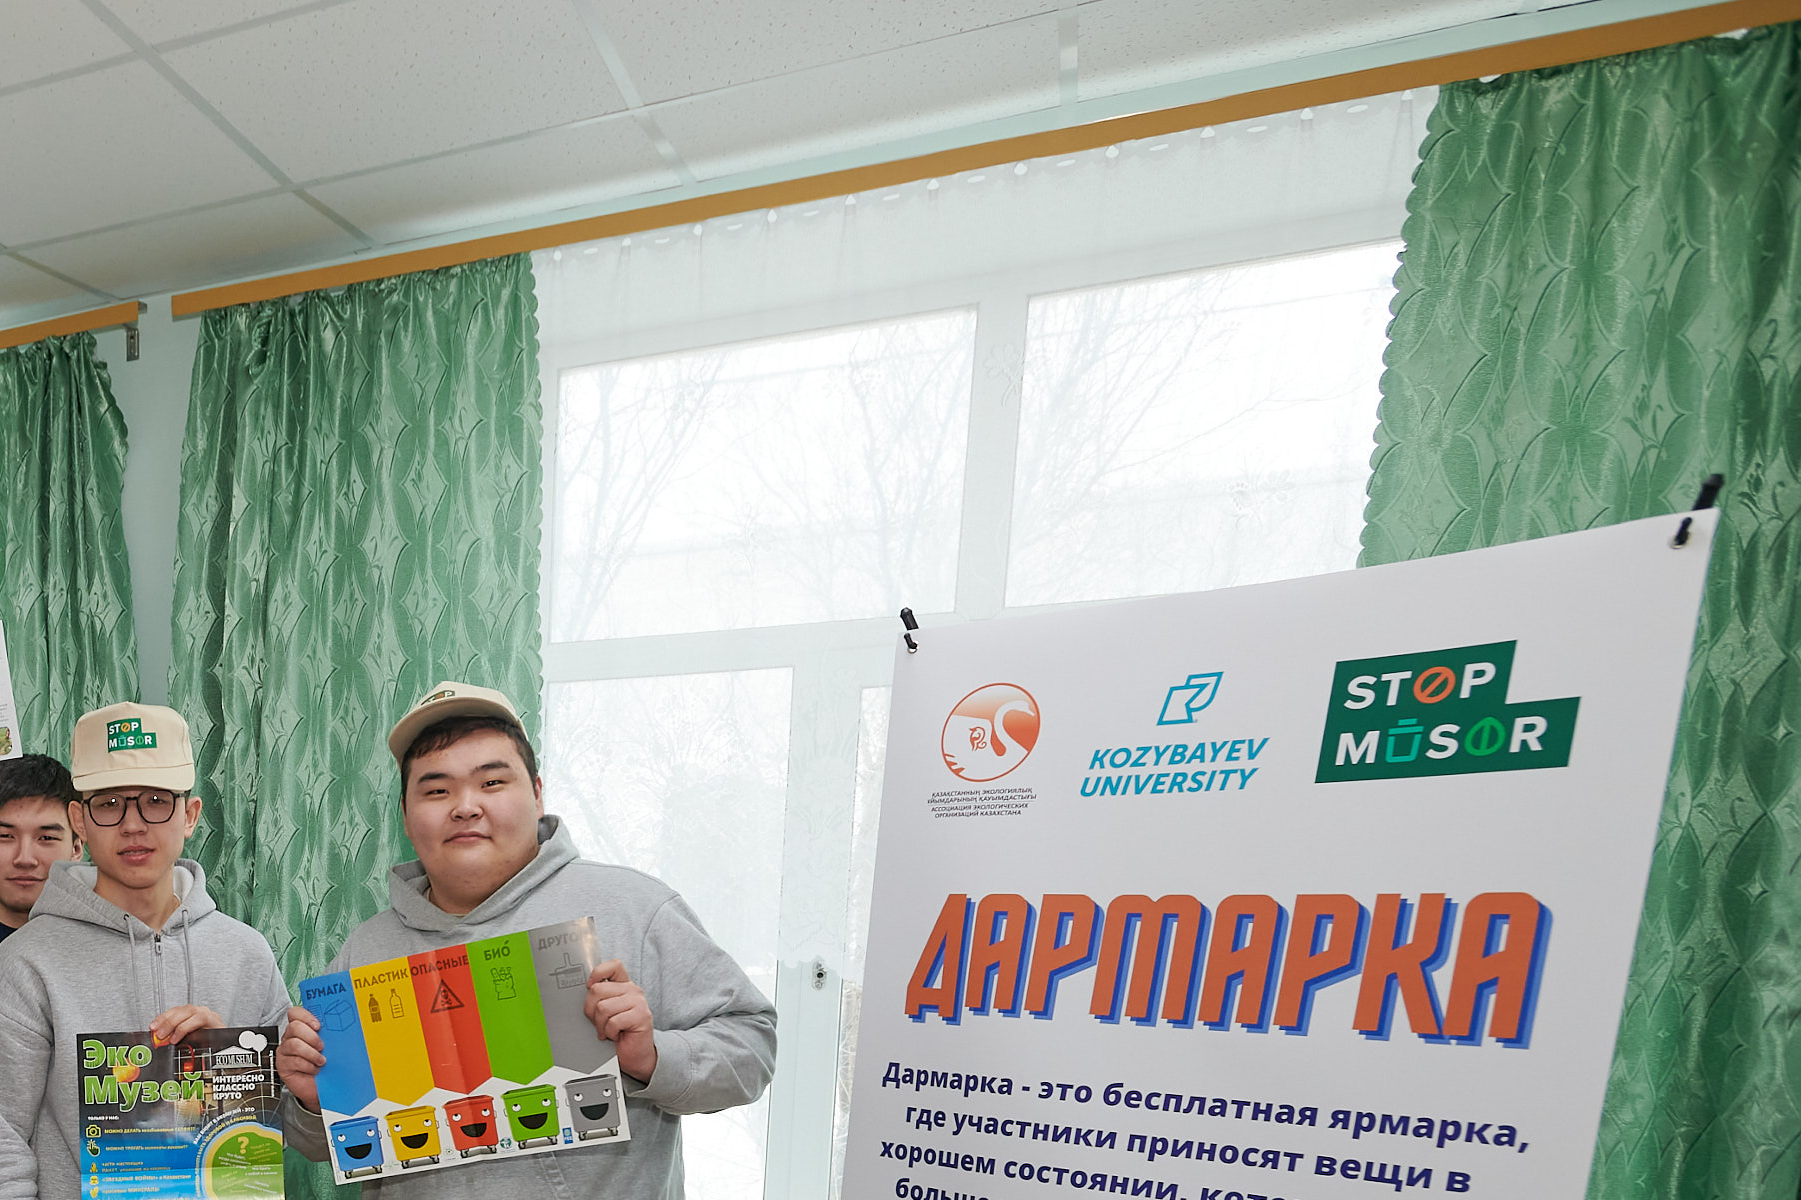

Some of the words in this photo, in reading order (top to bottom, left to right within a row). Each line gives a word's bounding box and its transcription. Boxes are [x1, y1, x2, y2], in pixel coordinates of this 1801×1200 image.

[1343, 662, 1497, 710] STOP
[109, 722, 139, 735] STOP
[1089, 737, 1270, 770] KOZYBAYEV
[1080, 767, 1259, 797] UNIVERSITY
[354, 968, 409, 989] ПЛАСТИК
[411, 955, 469, 976] ОПАСНЫЕ
[904, 892, 1553, 1050] ДАРМАРКА
[306, 983, 346, 1000] БУМАГА
[83, 1039, 152, 1069] Эко
[84, 1072, 204, 1112] Музей
[212, 1074, 265, 1083] ИНТЕРЕСНО
[213, 1083, 256, 1092] КЛАССНО
[213, 1091, 242, 1100] КРУТО
[882, 1062, 1014, 1097] Дармарка
[1038, 1081, 1092, 1103] это
[1103, 1082, 1319, 1127] бесплатная
[1328, 1109, 1530, 1154] ярмарка,
[879, 1141, 996, 1175] хорошем
[905, 1106, 946, 1131] где
[952, 1111, 1118, 1149] участники
[1127, 1133, 1304, 1172] приносят
[1314, 1155, 1433, 1192] вещи
[1445, 1171, 1472, 1193] в
